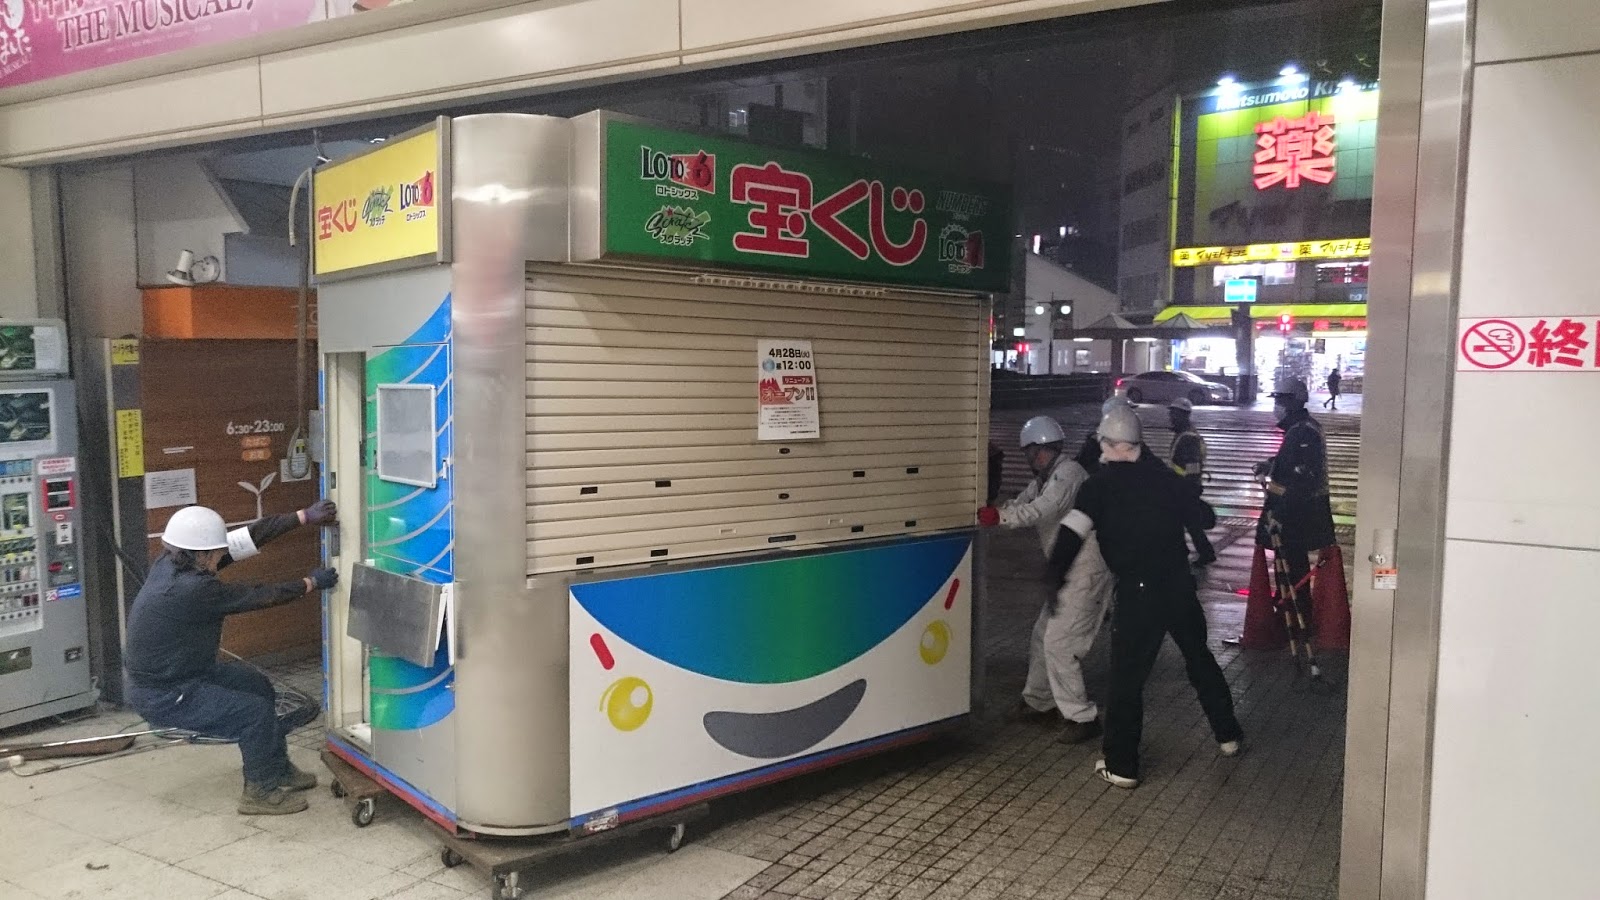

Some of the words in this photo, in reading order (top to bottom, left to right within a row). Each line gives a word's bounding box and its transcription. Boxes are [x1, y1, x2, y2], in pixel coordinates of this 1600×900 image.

[59, 8, 109, 49] THE
[1254, 111, 1336, 190] 薬
[656, 185, 699, 201] ロトシックス
[318, 197, 357, 240] 宝くじ
[406, 209, 426, 222] ロトシックス
[731, 161, 928, 267] 宝くじ
[660, 234, 694, 246] スクラッチ
[1196, 248, 1248, 261] マツモトキヨシ
[1526, 318, 1600, 368] 終
